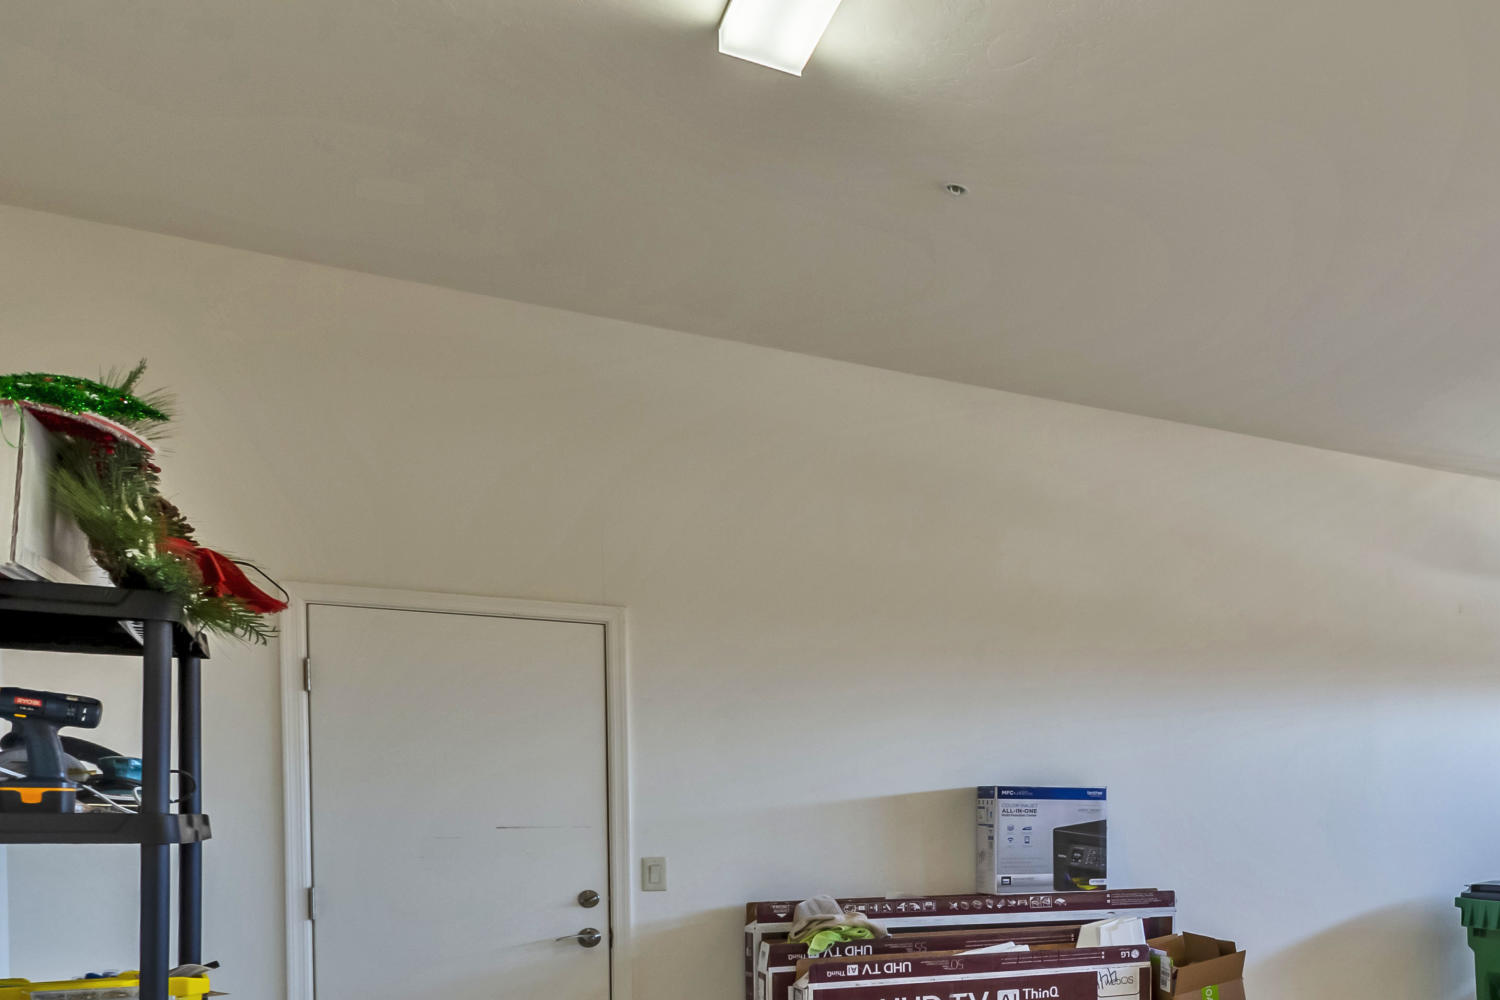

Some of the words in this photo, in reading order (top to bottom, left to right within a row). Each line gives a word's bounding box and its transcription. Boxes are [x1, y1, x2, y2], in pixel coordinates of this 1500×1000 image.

[844, 944, 873, 957] UHD
[826, 968, 846, 977] ThinQ
[861, 962, 881, 976] TV
[883, 961, 912, 975] UHD
[1022, 986, 1060, 1000] ThinQ
